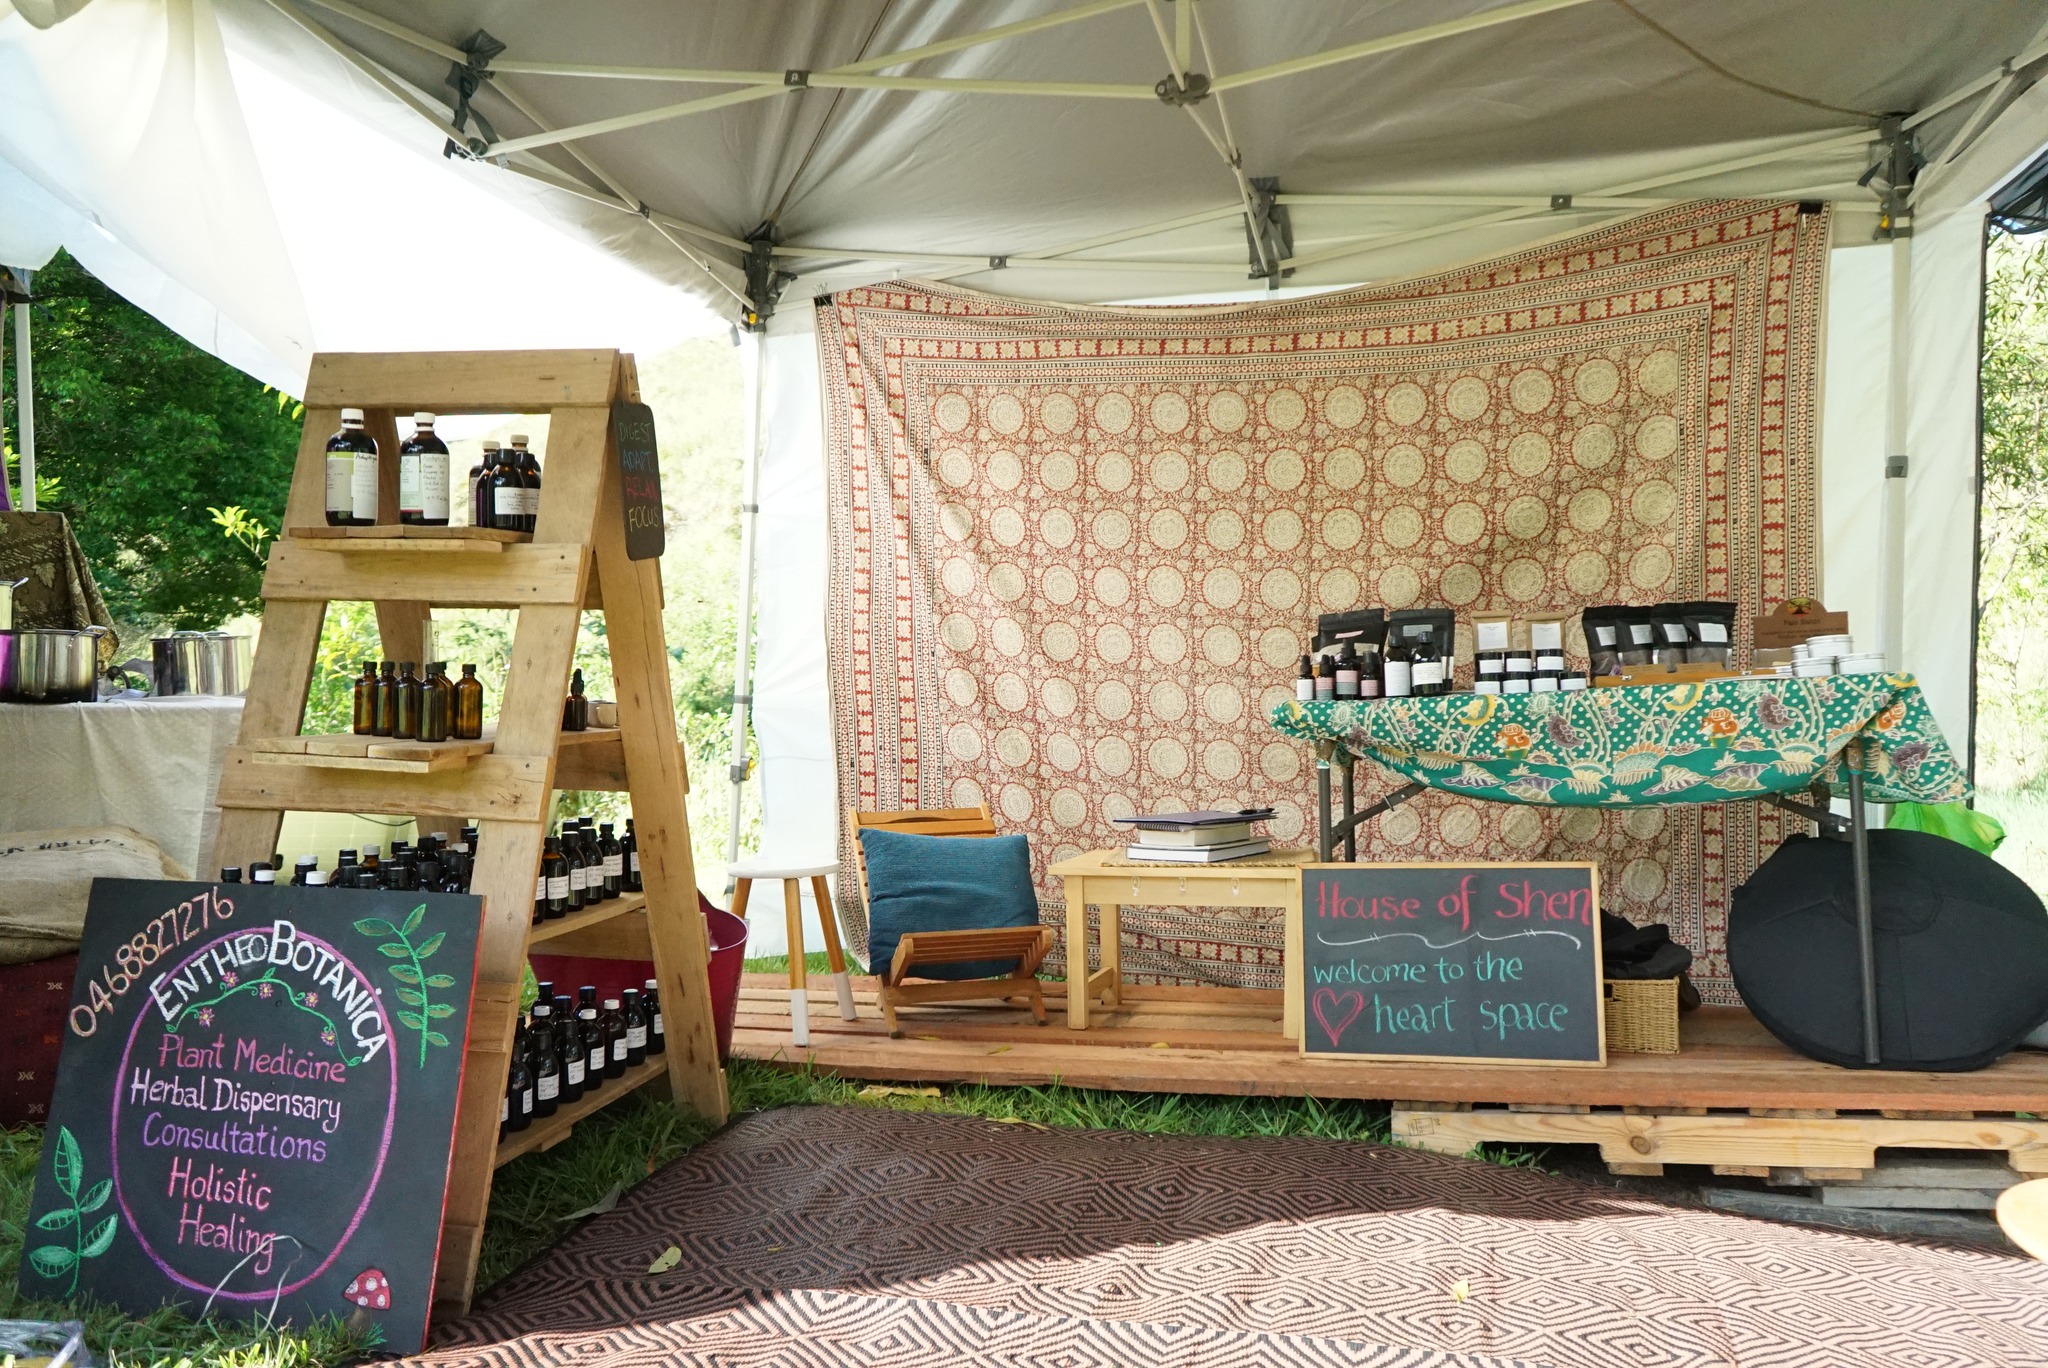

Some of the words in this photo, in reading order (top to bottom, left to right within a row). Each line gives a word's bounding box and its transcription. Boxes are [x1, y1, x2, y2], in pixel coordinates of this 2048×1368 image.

[1316, 880, 1421, 920] House
[1438, 874, 1480, 932] of
[1495, 880, 1593, 926] Shen
[70, 886, 235, 1037] 0468827276
[1313, 958, 1427, 984] welcome
[1434, 957, 1465, 982] to
[1473, 951, 1523, 982] the
[1373, 993, 1456, 1034] heart
[1479, 999, 1569, 1041] space
[158, 1033, 225, 1069] Plant
[234, 1039, 347, 1084] Medicine
[131, 1067, 208, 1111] Herbal
[213, 1077, 341, 1133] Dispensary
[143, 1111, 327, 1162] Consultations
[169, 1156, 271, 1211] Holistic
[178, 1203, 276, 1275] Healing
